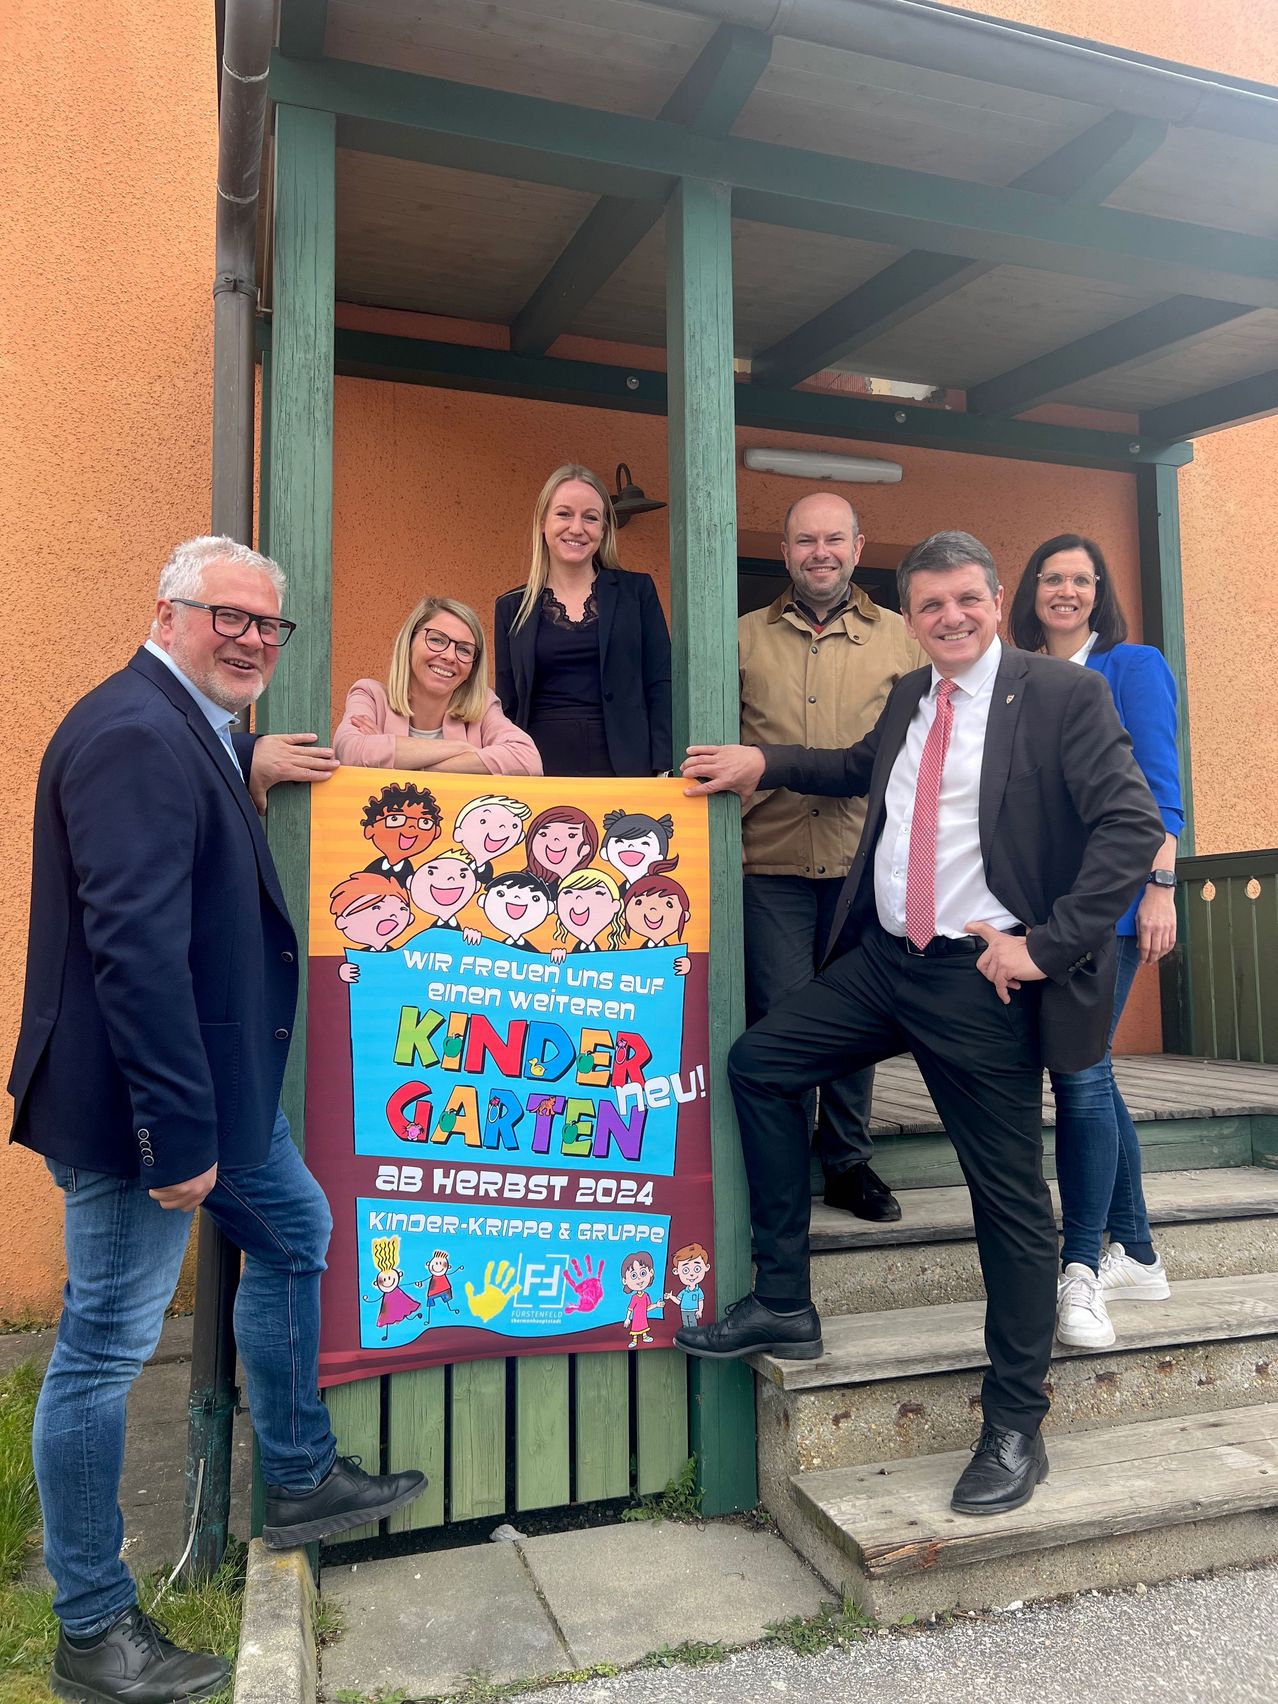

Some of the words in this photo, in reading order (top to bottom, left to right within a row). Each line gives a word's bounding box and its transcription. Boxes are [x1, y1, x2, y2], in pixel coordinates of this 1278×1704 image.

[402, 949, 453, 973] WIR
[392, 1005, 654, 1088] KINDER
[614, 1064, 707, 1116] neu!
[385, 1080, 648, 1162] GARTEN
[575, 1177, 654, 1206] 2024
[558, 1221, 572, 1241] &
[511, 1309, 563, 1319] FÜRSTENFELD
